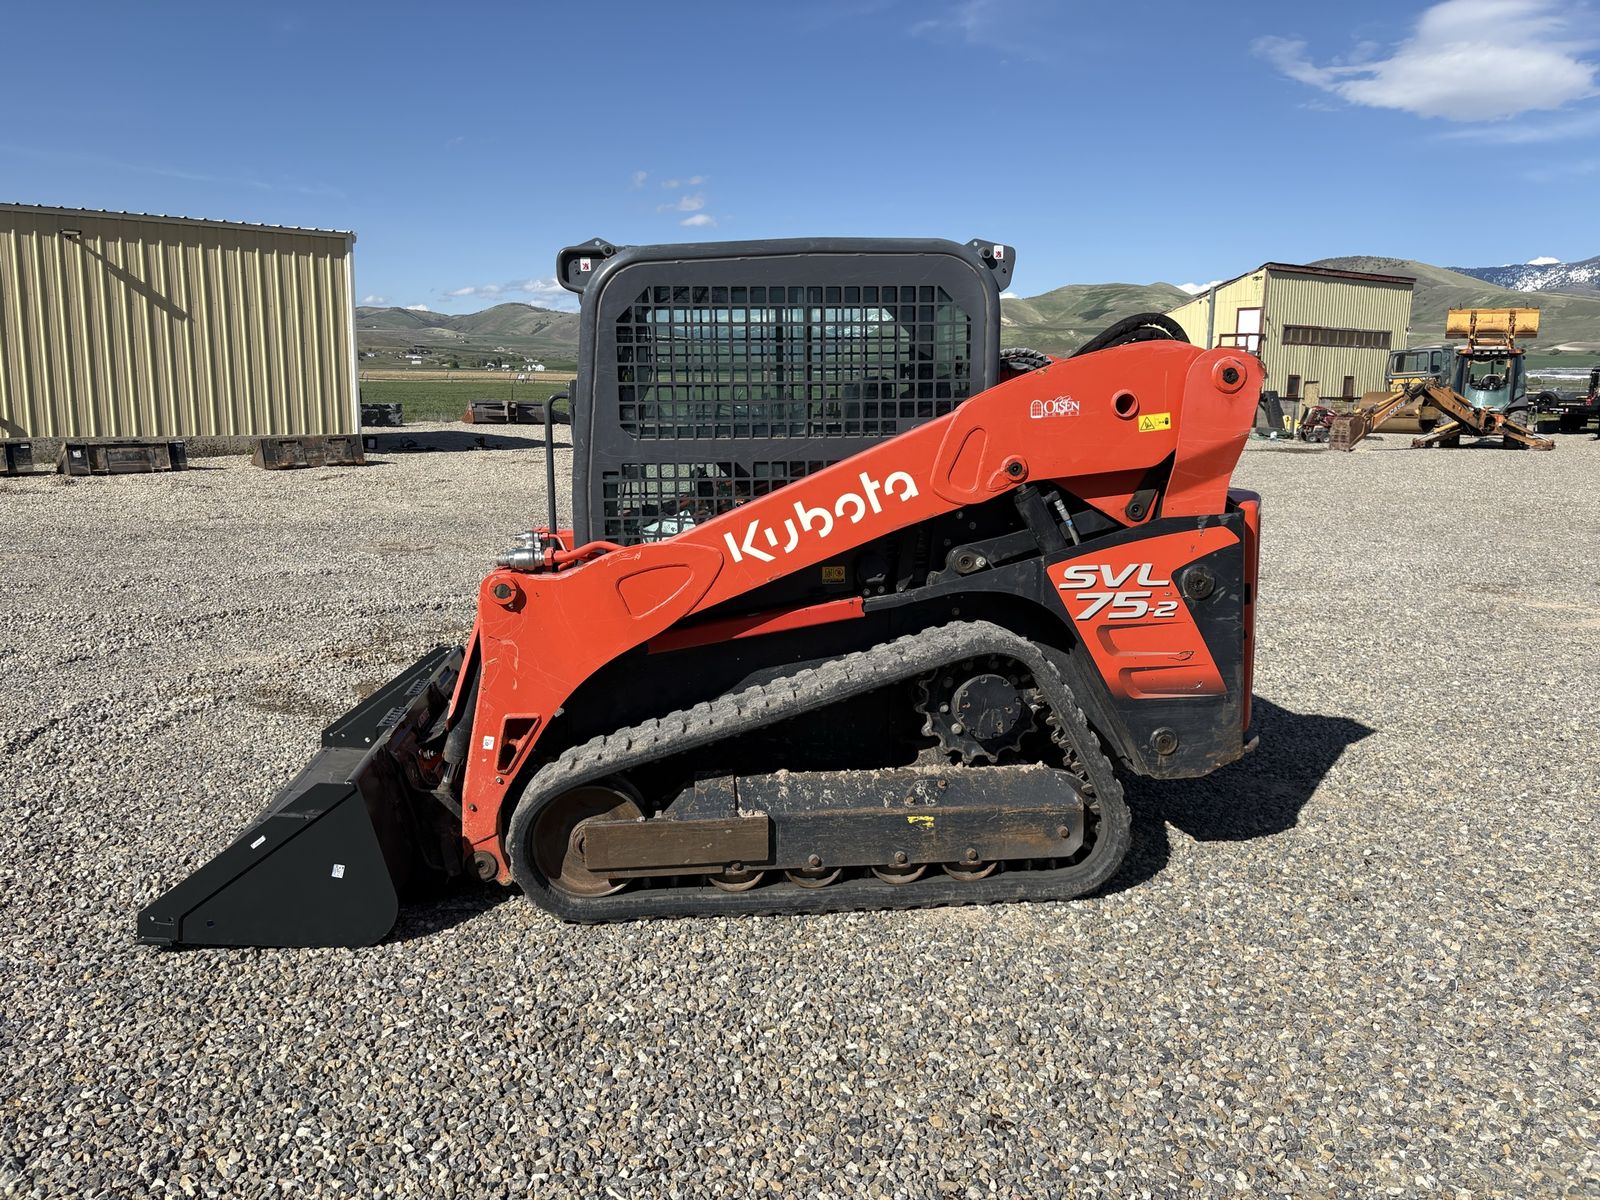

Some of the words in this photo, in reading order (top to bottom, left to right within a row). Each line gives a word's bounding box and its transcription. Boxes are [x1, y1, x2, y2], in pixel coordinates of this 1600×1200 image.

[723, 471, 919, 563] Kubota
[1059, 563, 1170, 590] SVL
[1075, 591, 1178, 620] 75-2
